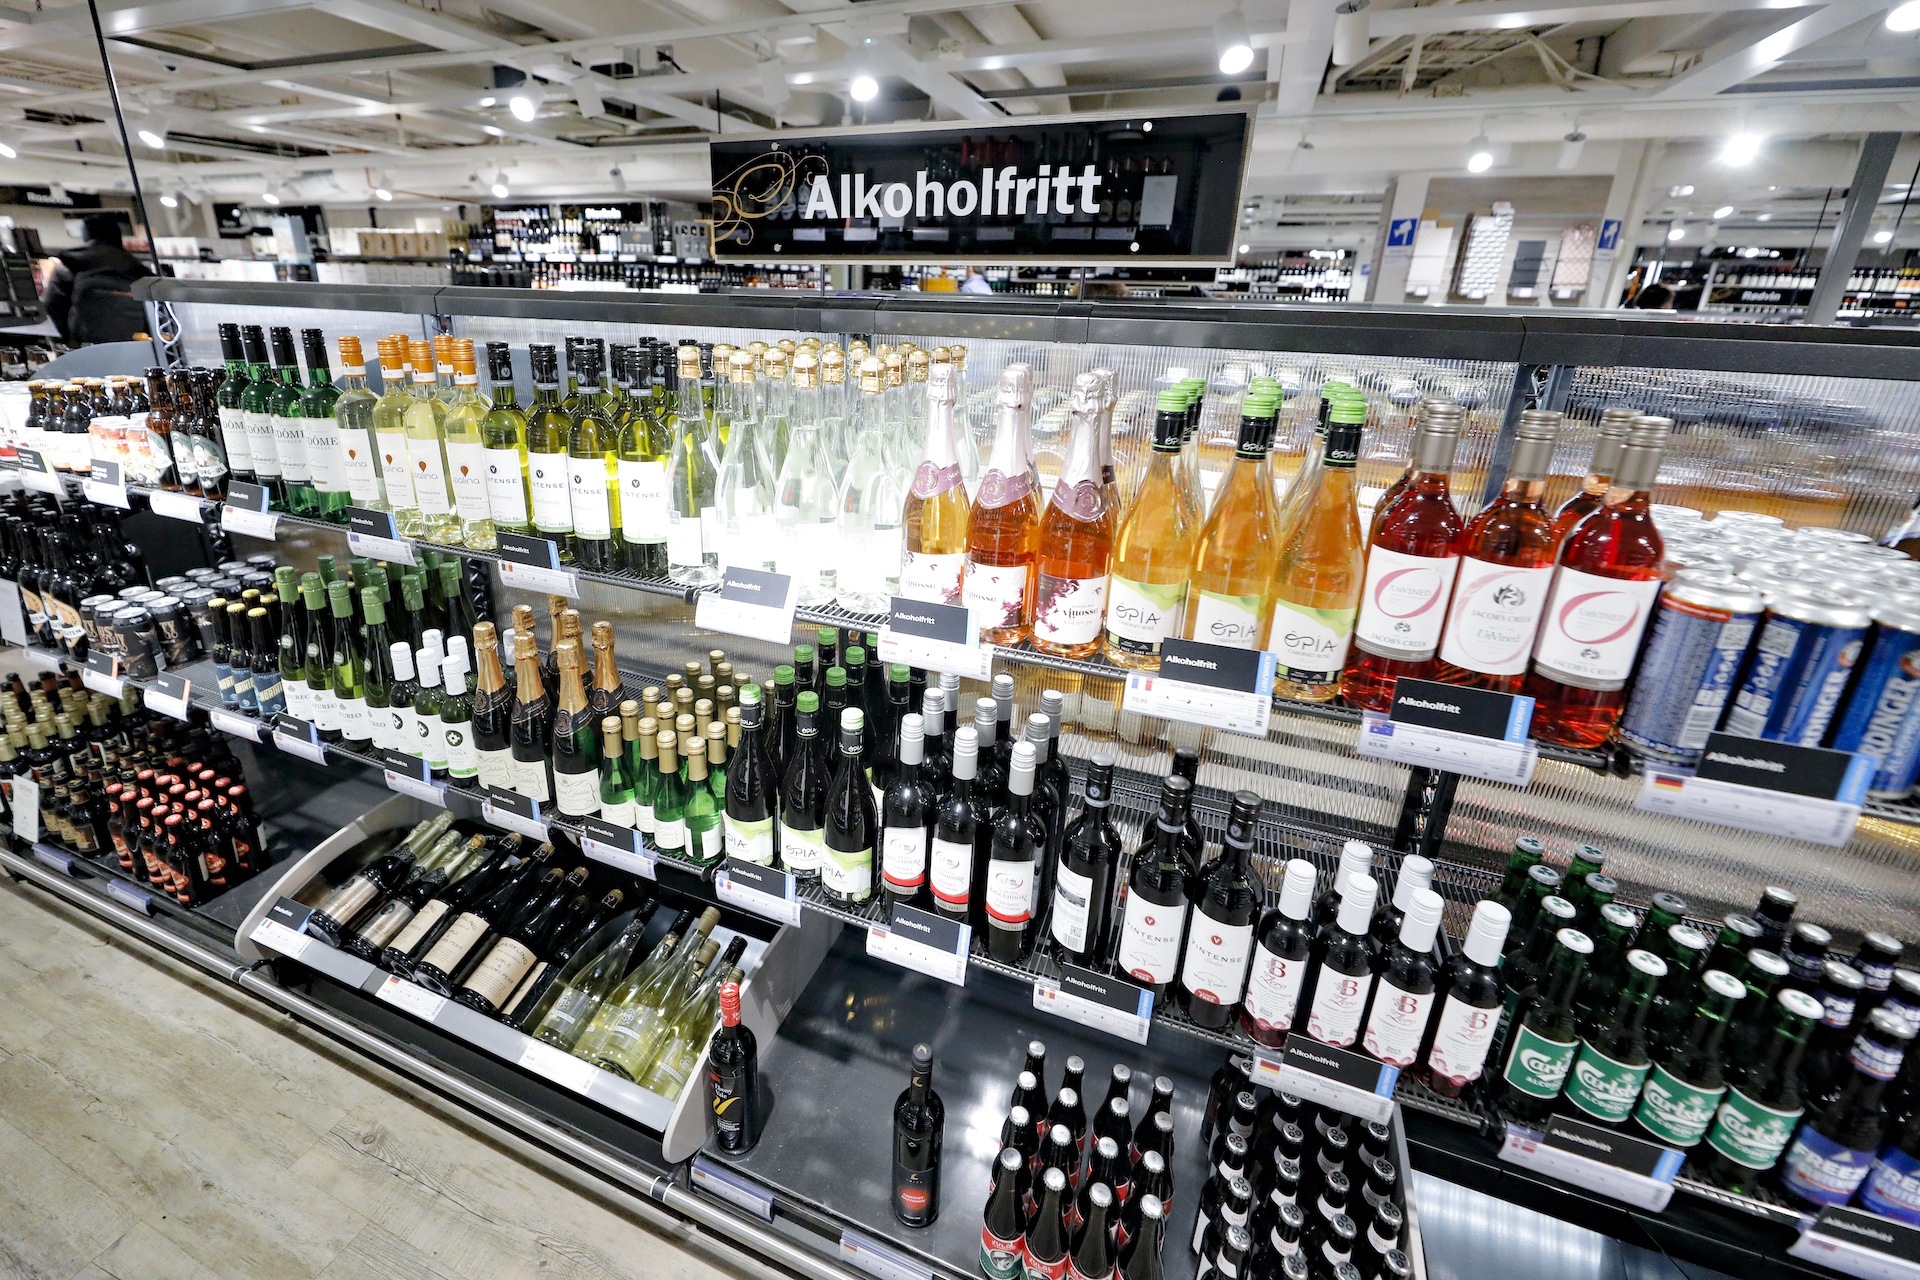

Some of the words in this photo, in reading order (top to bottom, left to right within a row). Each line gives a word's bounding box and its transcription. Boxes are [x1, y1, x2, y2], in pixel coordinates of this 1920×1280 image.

[805, 164, 1101, 221] Alkoholfritt
[727, 580, 761, 592] Alkoholfritt
[894, 611, 935, 625] Alkoholfritt
[1165, 654, 1217, 671] Alkoholfritt
[1398, 696, 1461, 715] Alkoholfritt
[731, 866, 762, 882] Alkoholfritt
[895, 916, 931, 934] Alkoholfritt
[1269, 957, 1286, 978] B
[1065, 975, 1108, 995] Alkoholfritt
[1340, 977, 1358, 997] B
[1398, 994, 1418, 1014] B
[1469, 1010, 1488, 1030] B
[1290, 1047, 1341, 1069] Alkoholfritt
